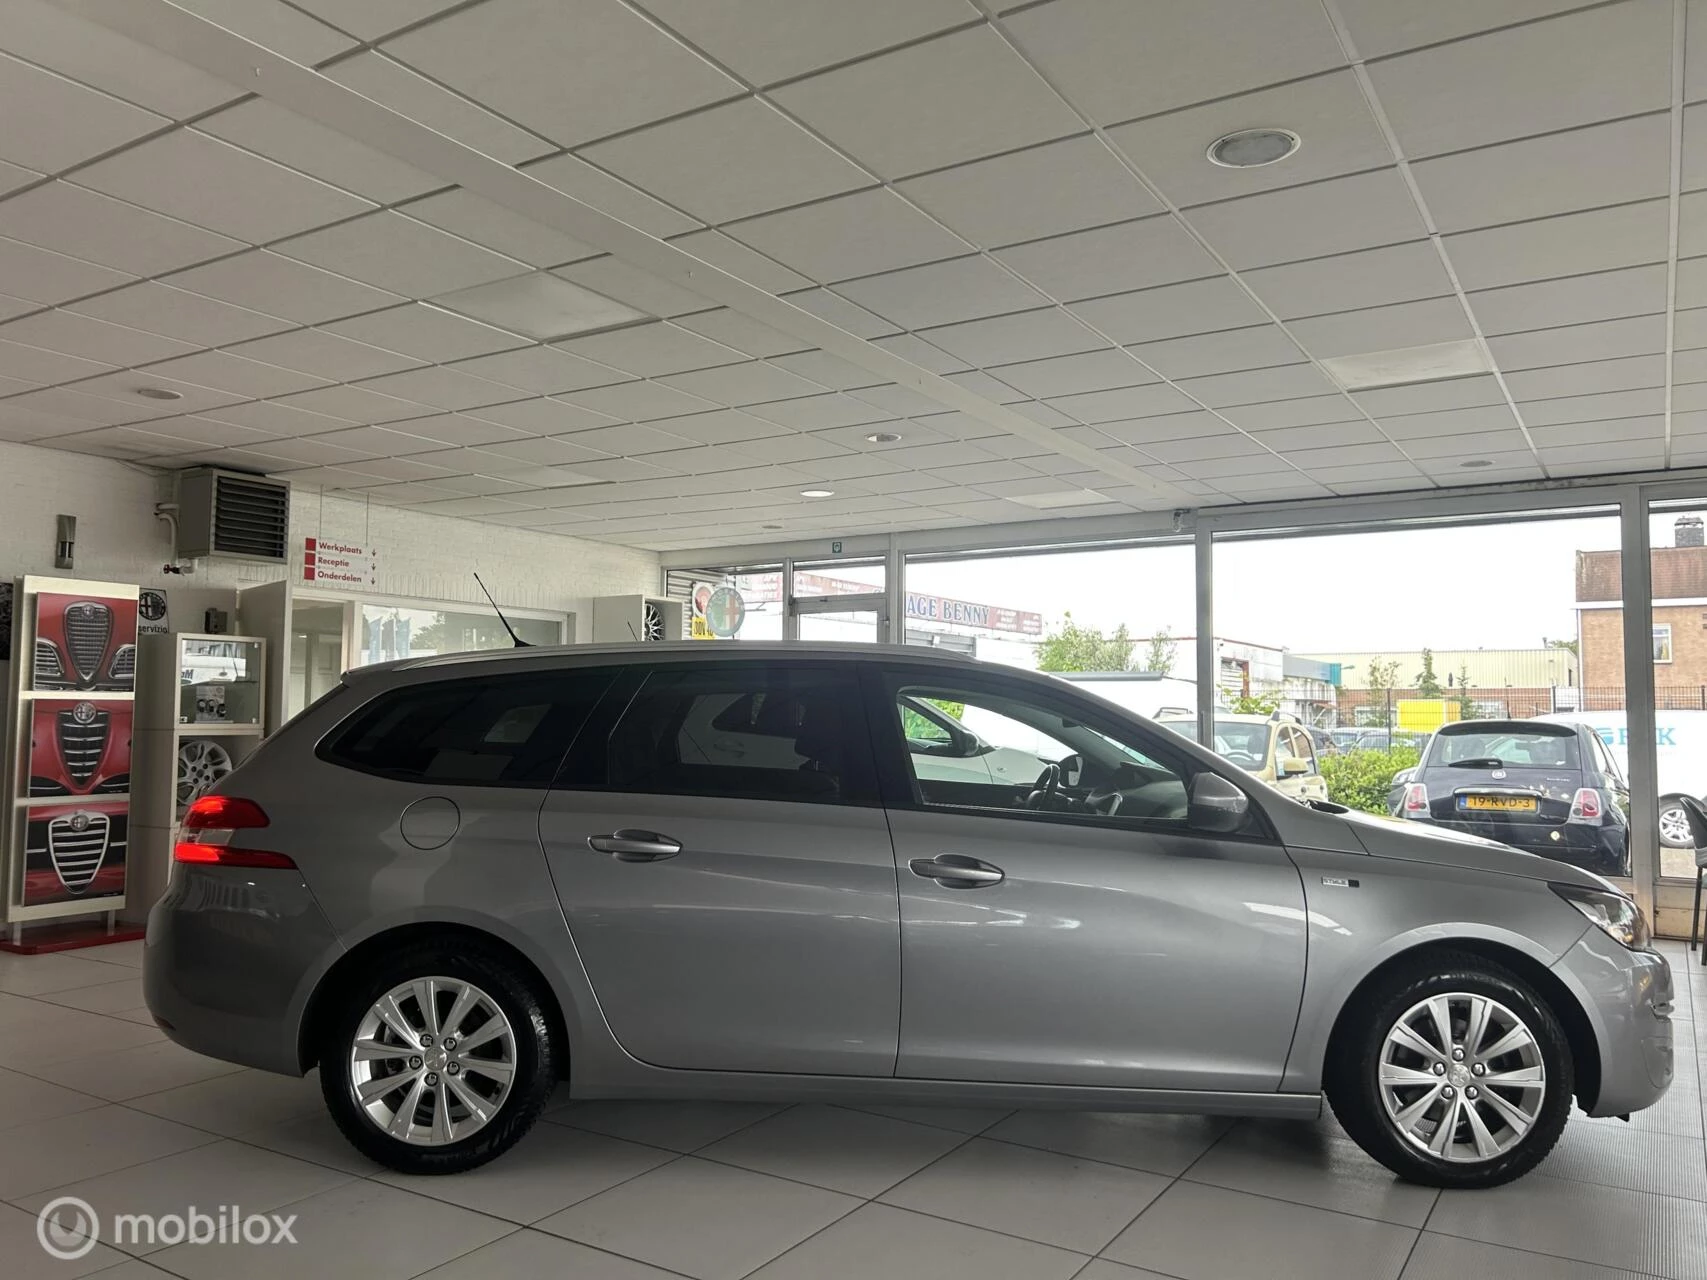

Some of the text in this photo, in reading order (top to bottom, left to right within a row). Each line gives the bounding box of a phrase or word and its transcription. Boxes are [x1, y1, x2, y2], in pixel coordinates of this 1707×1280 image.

[319, 542, 362, 555] Werkplaats
[318, 557, 350, 567] Receptie
[317, 571, 362, 582] Onderdelen
[906, 594, 937, 618] AGE
[943, 600, 990, 625] BENNY
[1473, 796, 1530, 808] 19-RVD-3
